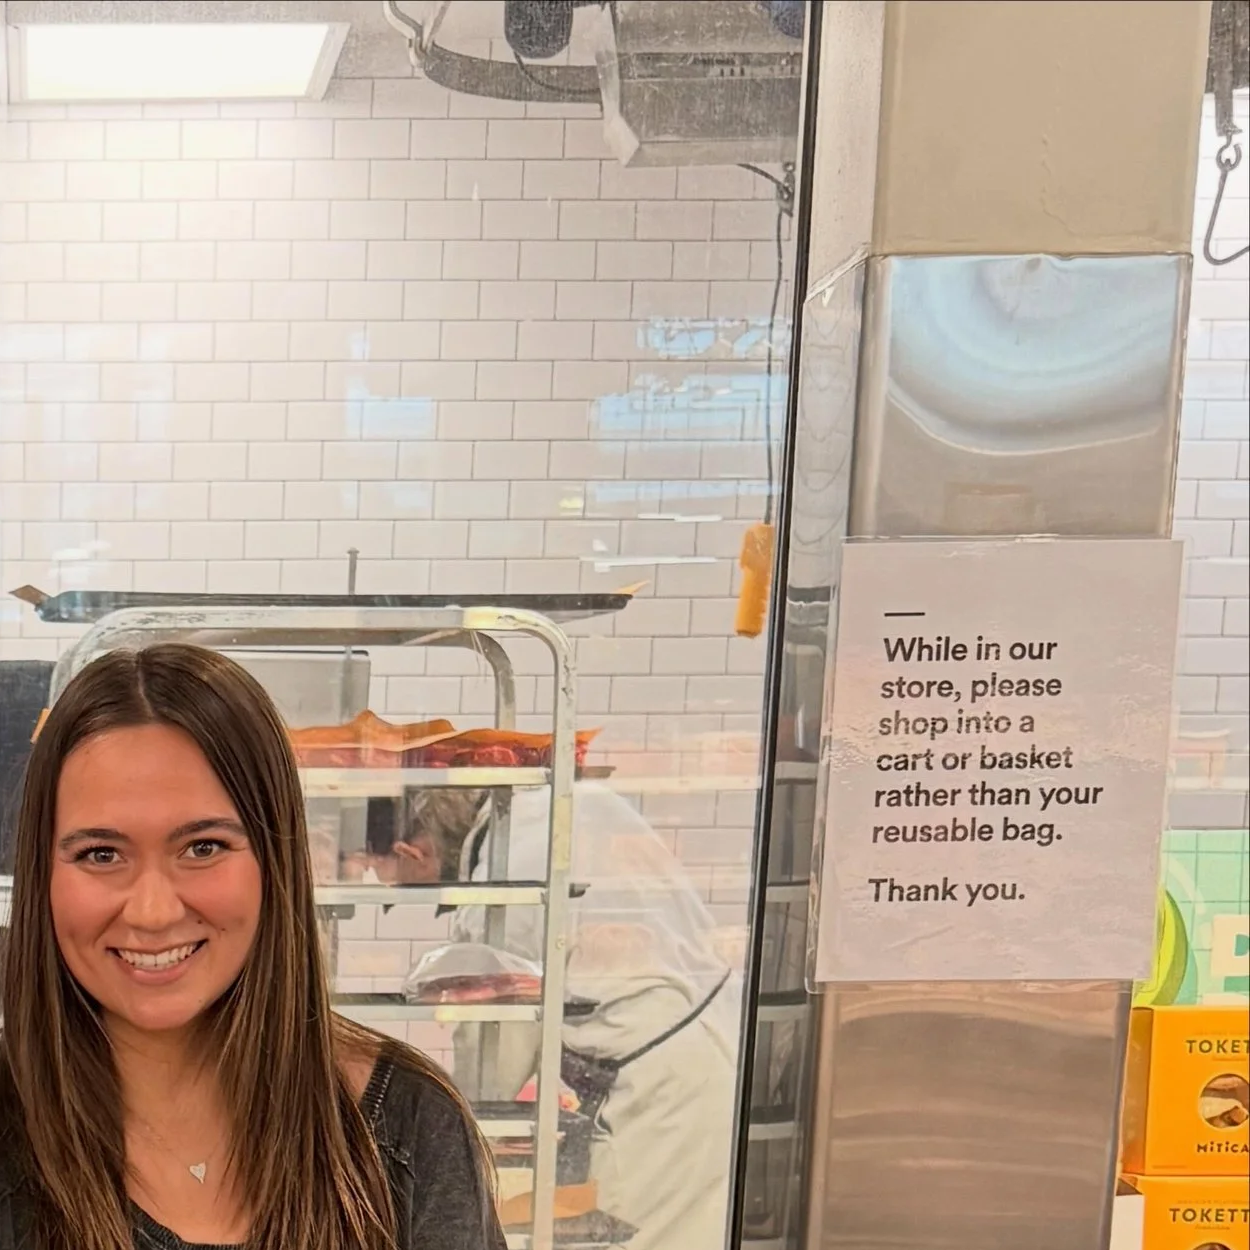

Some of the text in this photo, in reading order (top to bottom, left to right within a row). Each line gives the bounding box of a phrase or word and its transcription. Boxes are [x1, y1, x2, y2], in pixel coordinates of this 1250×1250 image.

[883, 635, 1057, 661] While in our
[880, 673, 1062, 702] store, please
[879, 709, 1034, 740] shop into a
[876, 745, 1073, 771] cart or basket
[874, 782, 1103, 810] rather than your
[872, 817, 1062, 846] reusable bag.
[868, 877, 1025, 907] Thank you.
[1169, 1207, 1249, 1222] TOKETT
